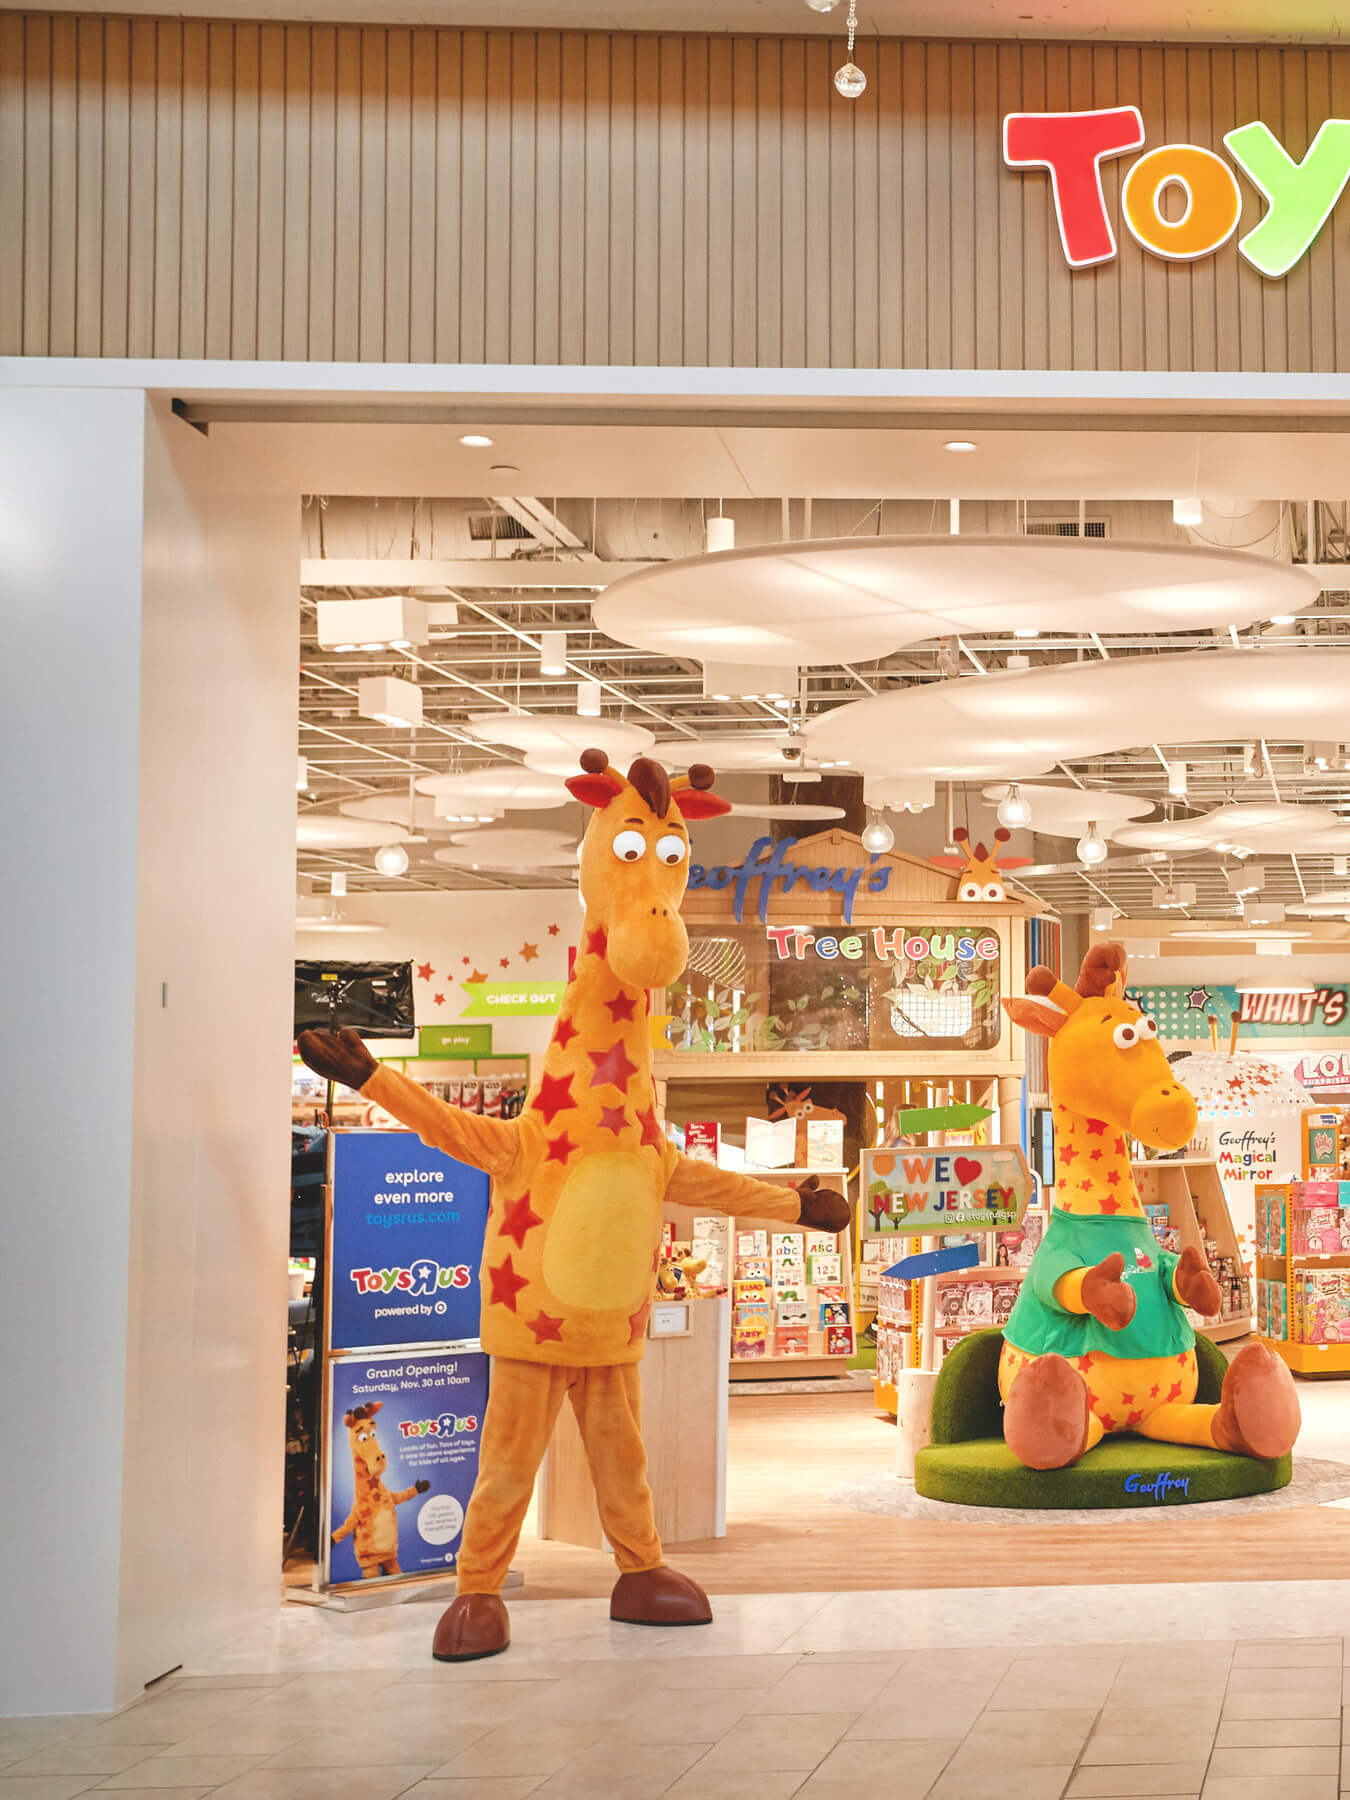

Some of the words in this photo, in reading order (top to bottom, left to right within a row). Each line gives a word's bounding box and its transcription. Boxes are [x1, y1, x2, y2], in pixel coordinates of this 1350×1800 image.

[688, 836, 893, 925] eoffrey's
[766, 926, 864, 961] Tree
[872, 926, 1000, 961] House
[486, 993, 527, 1005] CHECK
[530, 993, 557, 1004] OUT
[1240, 989, 1346, 1025] WHAT'S
[1219, 1130, 1277, 1152] Geoffrey's
[1219, 1150, 1277, 1166] Magical
[385, 1169, 444, 1186] explore
[902, 1156, 950, 1184] WE
[1224, 1168, 1272, 1180] Mirror
[374, 1193, 411, 1205] even
[415, 1191, 454, 1204] more
[873, 1191, 929, 1214] NEW
[933, 1186, 1015, 1211] JERSEY
[365, 1211, 460, 1229] toysrus.com
[775, 1246, 798, 1256] abc
[810, 1244, 833, 1256] ABC
[817, 1265, 836, 1275] 123
[374, 1304, 419, 1319] powered
[420, 1304, 433, 1315] by
[366, 1366, 403, 1379] Grand
[406, 1361, 458, 1378] Opening!
[352, 1382, 399, 1394] Saturday,
[400, 1380, 420, 1390] Nov.
[422, 1378, 433, 1387] 30
[434, 1378, 445, 1386] at
[447, 1376, 471, 1385] 10am
[1125, 1472, 1190, 1501] Geoffrey
